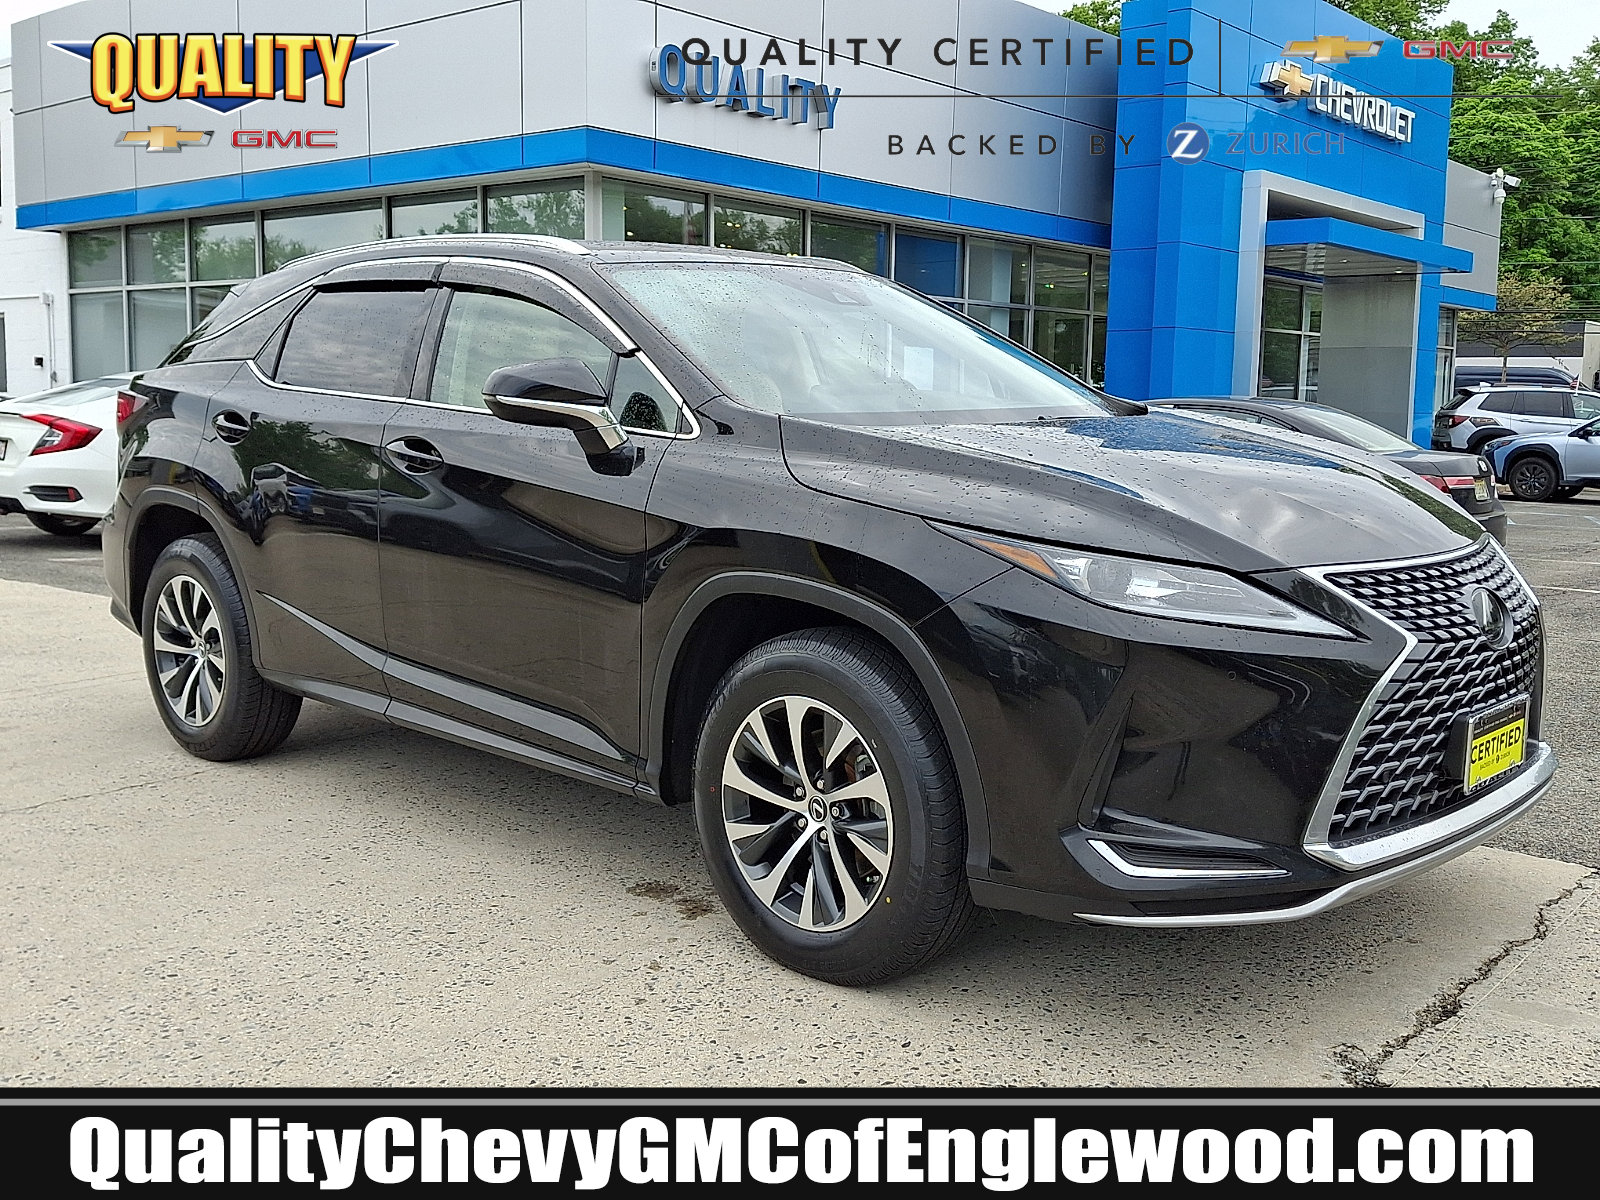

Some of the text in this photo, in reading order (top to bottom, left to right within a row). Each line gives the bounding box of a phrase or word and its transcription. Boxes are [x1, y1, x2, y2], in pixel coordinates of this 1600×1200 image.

[652, 43, 842, 130] QUALITY
[1314, 73, 1416, 144] CHEVROLET
[1470, 725, 1522, 765] CERTIFIED
